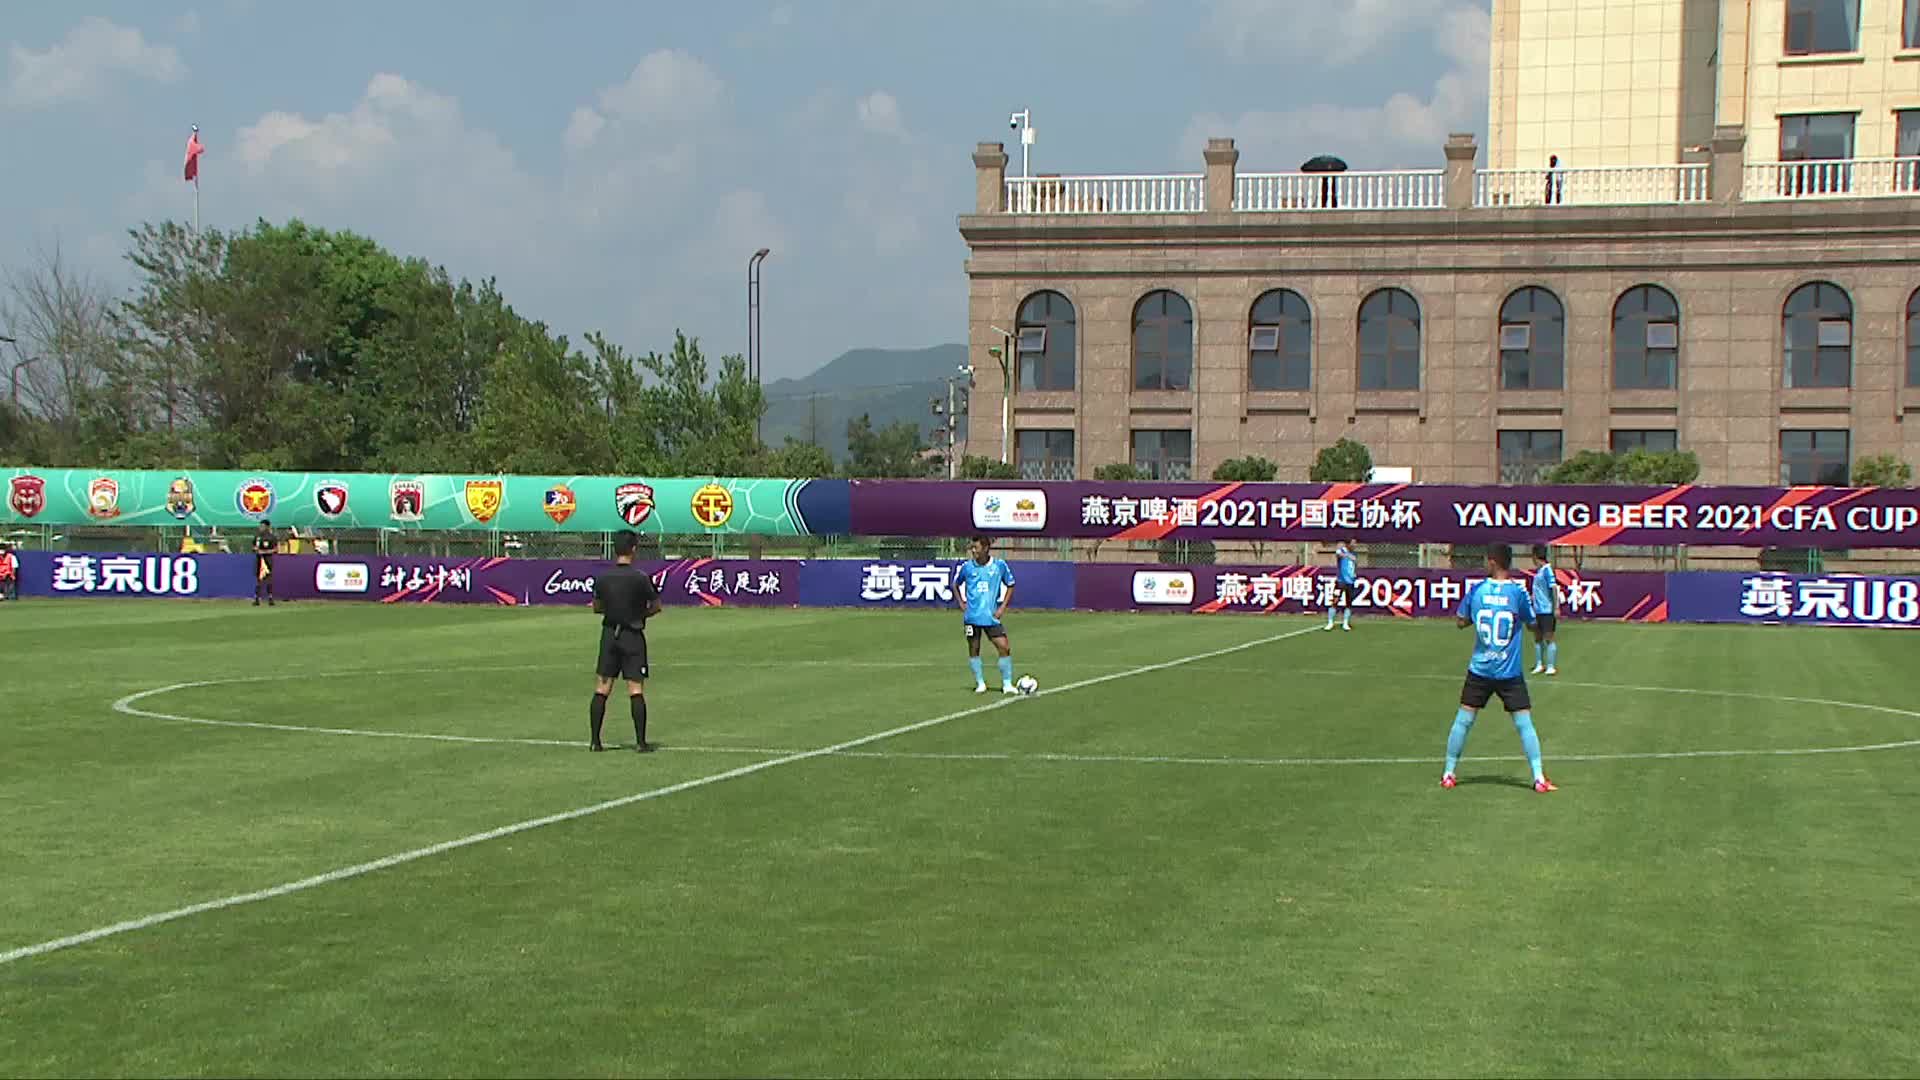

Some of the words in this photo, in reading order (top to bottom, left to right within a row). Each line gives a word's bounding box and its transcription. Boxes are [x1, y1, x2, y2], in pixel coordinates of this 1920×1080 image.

[1082, 495, 1420, 529] 燕京啤酒2021中国足协杯
[1453, 503, 1590, 527] YANJING
[1599, 504, 1688, 528] BEER
[1697, 505, 1762, 529] 2021
[1771, 506, 1838, 531] CFA
[1847, 507, 1919, 531] CUP
[53, 555, 199, 594] 燕京U8
[544, 569, 595, 594] Game
[684, 569, 781, 595] 全民足球
[1740, 577, 1919, 622] 燕京U8
